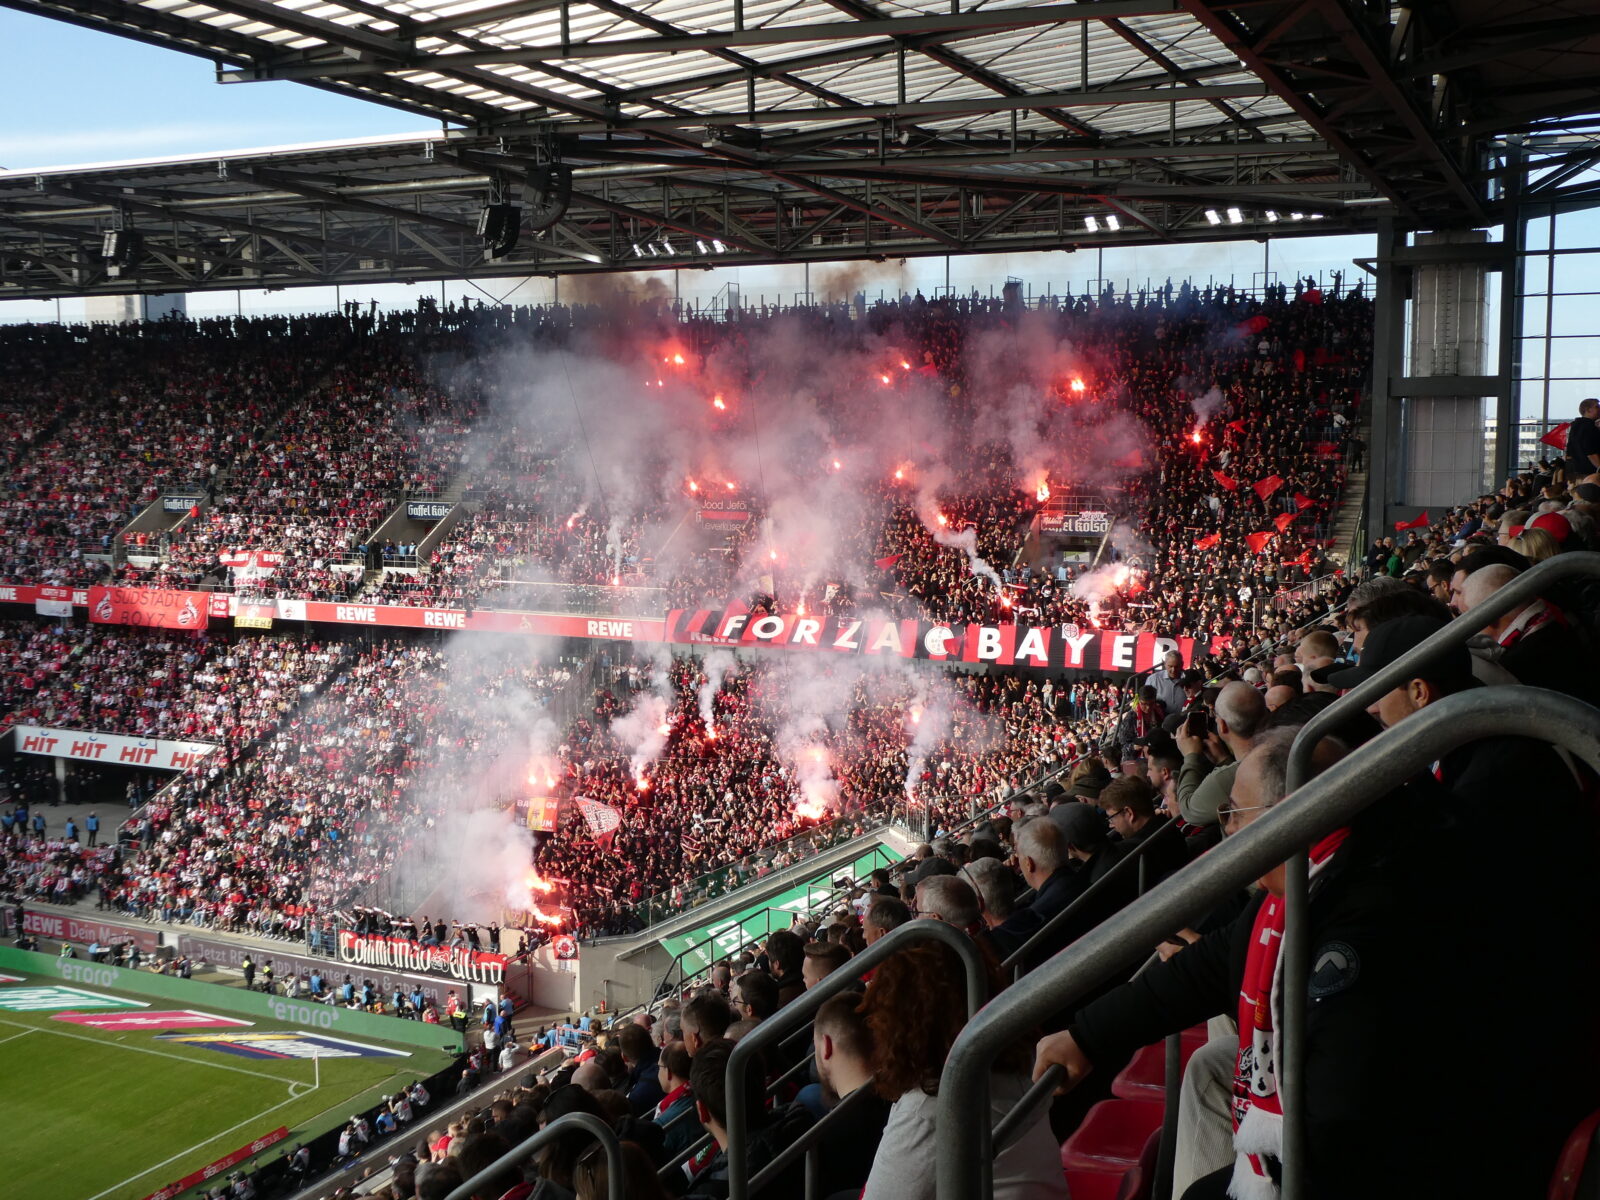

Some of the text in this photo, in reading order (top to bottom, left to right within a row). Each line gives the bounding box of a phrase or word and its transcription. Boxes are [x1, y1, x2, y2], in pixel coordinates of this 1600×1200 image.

[701, 520, 742, 532] Leverkuse
[336, 605, 377, 622] REWE
[424, 611, 465, 628] REWE
[587, 620, 633, 638] REWE
[722, 615, 901, 651] FORZA
[977, 627, 1179, 668] BAYER
[22, 735, 59, 753] HIT
[70, 740, 107, 759] HIT
[119, 745, 158, 765] HIT
[23, 913, 63, 936] REWE
[69, 921, 96, 941] Dein
[197, 944, 227, 963] Jetzt
